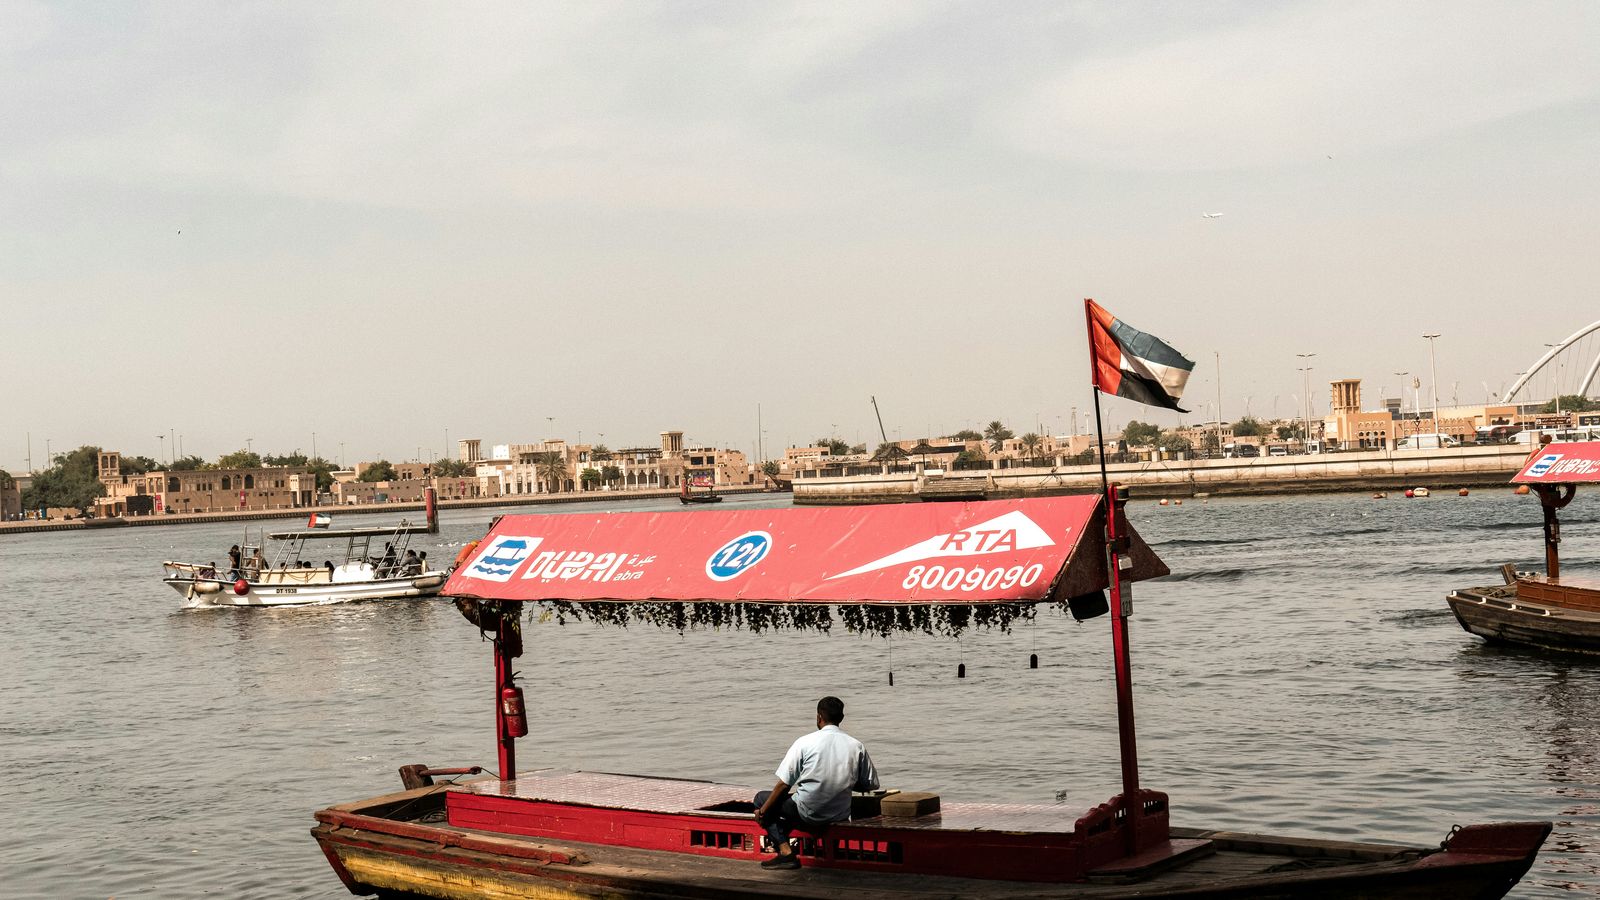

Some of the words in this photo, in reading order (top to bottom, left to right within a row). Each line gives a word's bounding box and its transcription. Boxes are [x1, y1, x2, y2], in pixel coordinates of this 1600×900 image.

[939, 529, 1017, 551] RTA
[521, 551, 629, 583] DUBAI
[627, 554, 657, 568] عبرة
[714, 542, 767, 569] 121
[613, 570, 645, 581] abra
[902, 563, 1044, 592] 8009090
